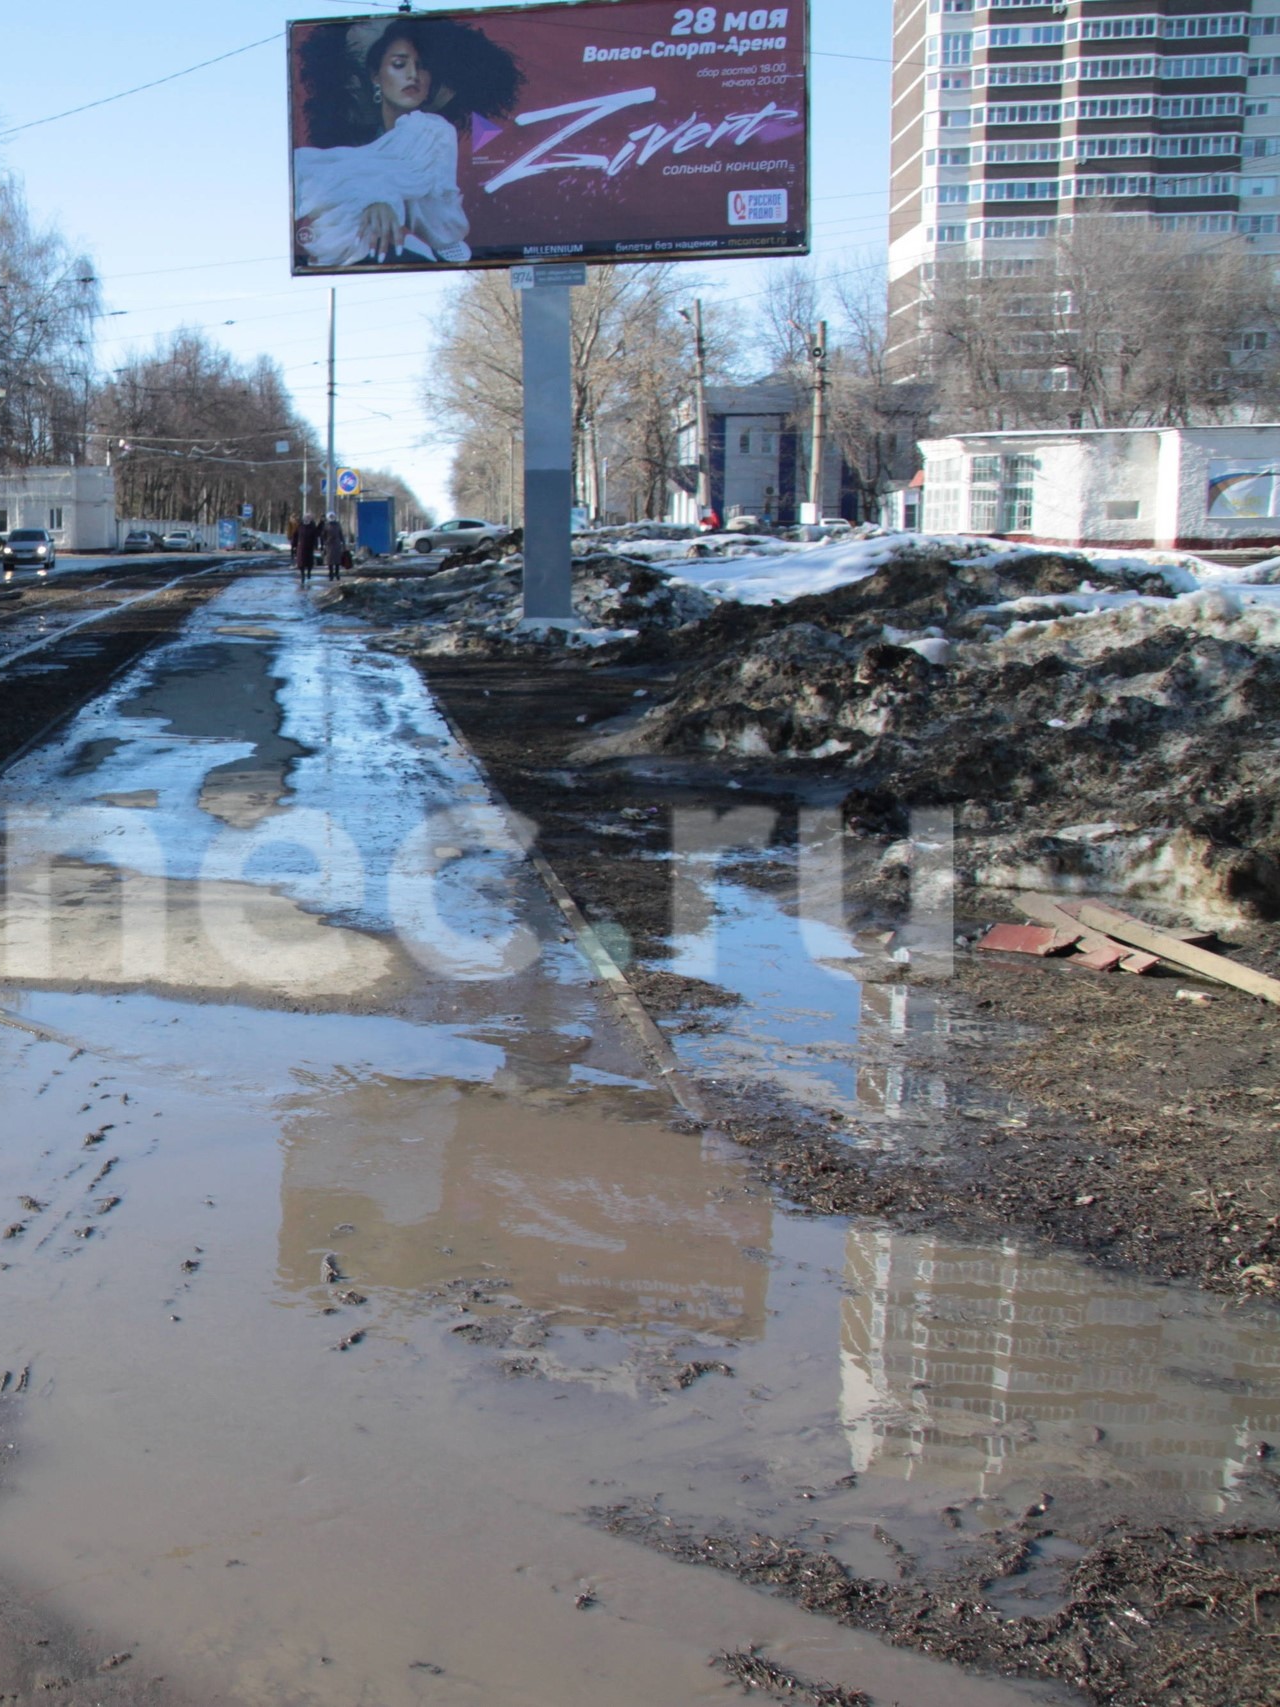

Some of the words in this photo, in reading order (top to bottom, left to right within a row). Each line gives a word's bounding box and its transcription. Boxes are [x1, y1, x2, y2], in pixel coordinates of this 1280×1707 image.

[670, 7, 717, 36] 28
[723, 8, 789, 32] мая
[582, 36, 787, 62] Волга-Спорт-Арена
[696, 67, 719, 79] сбор
[483, 87, 798, 194] Zivert
[663, 161, 722, 175] сольный
[725, 159, 789, 174] концерт
[748, 193, 782, 206] РУССКОЕ
[523, 244, 583, 255] MILLENNIUM
[615, 240, 652, 252] билеты
[655, 240, 673, 250] без
[675, 238, 718, 249] наценки
